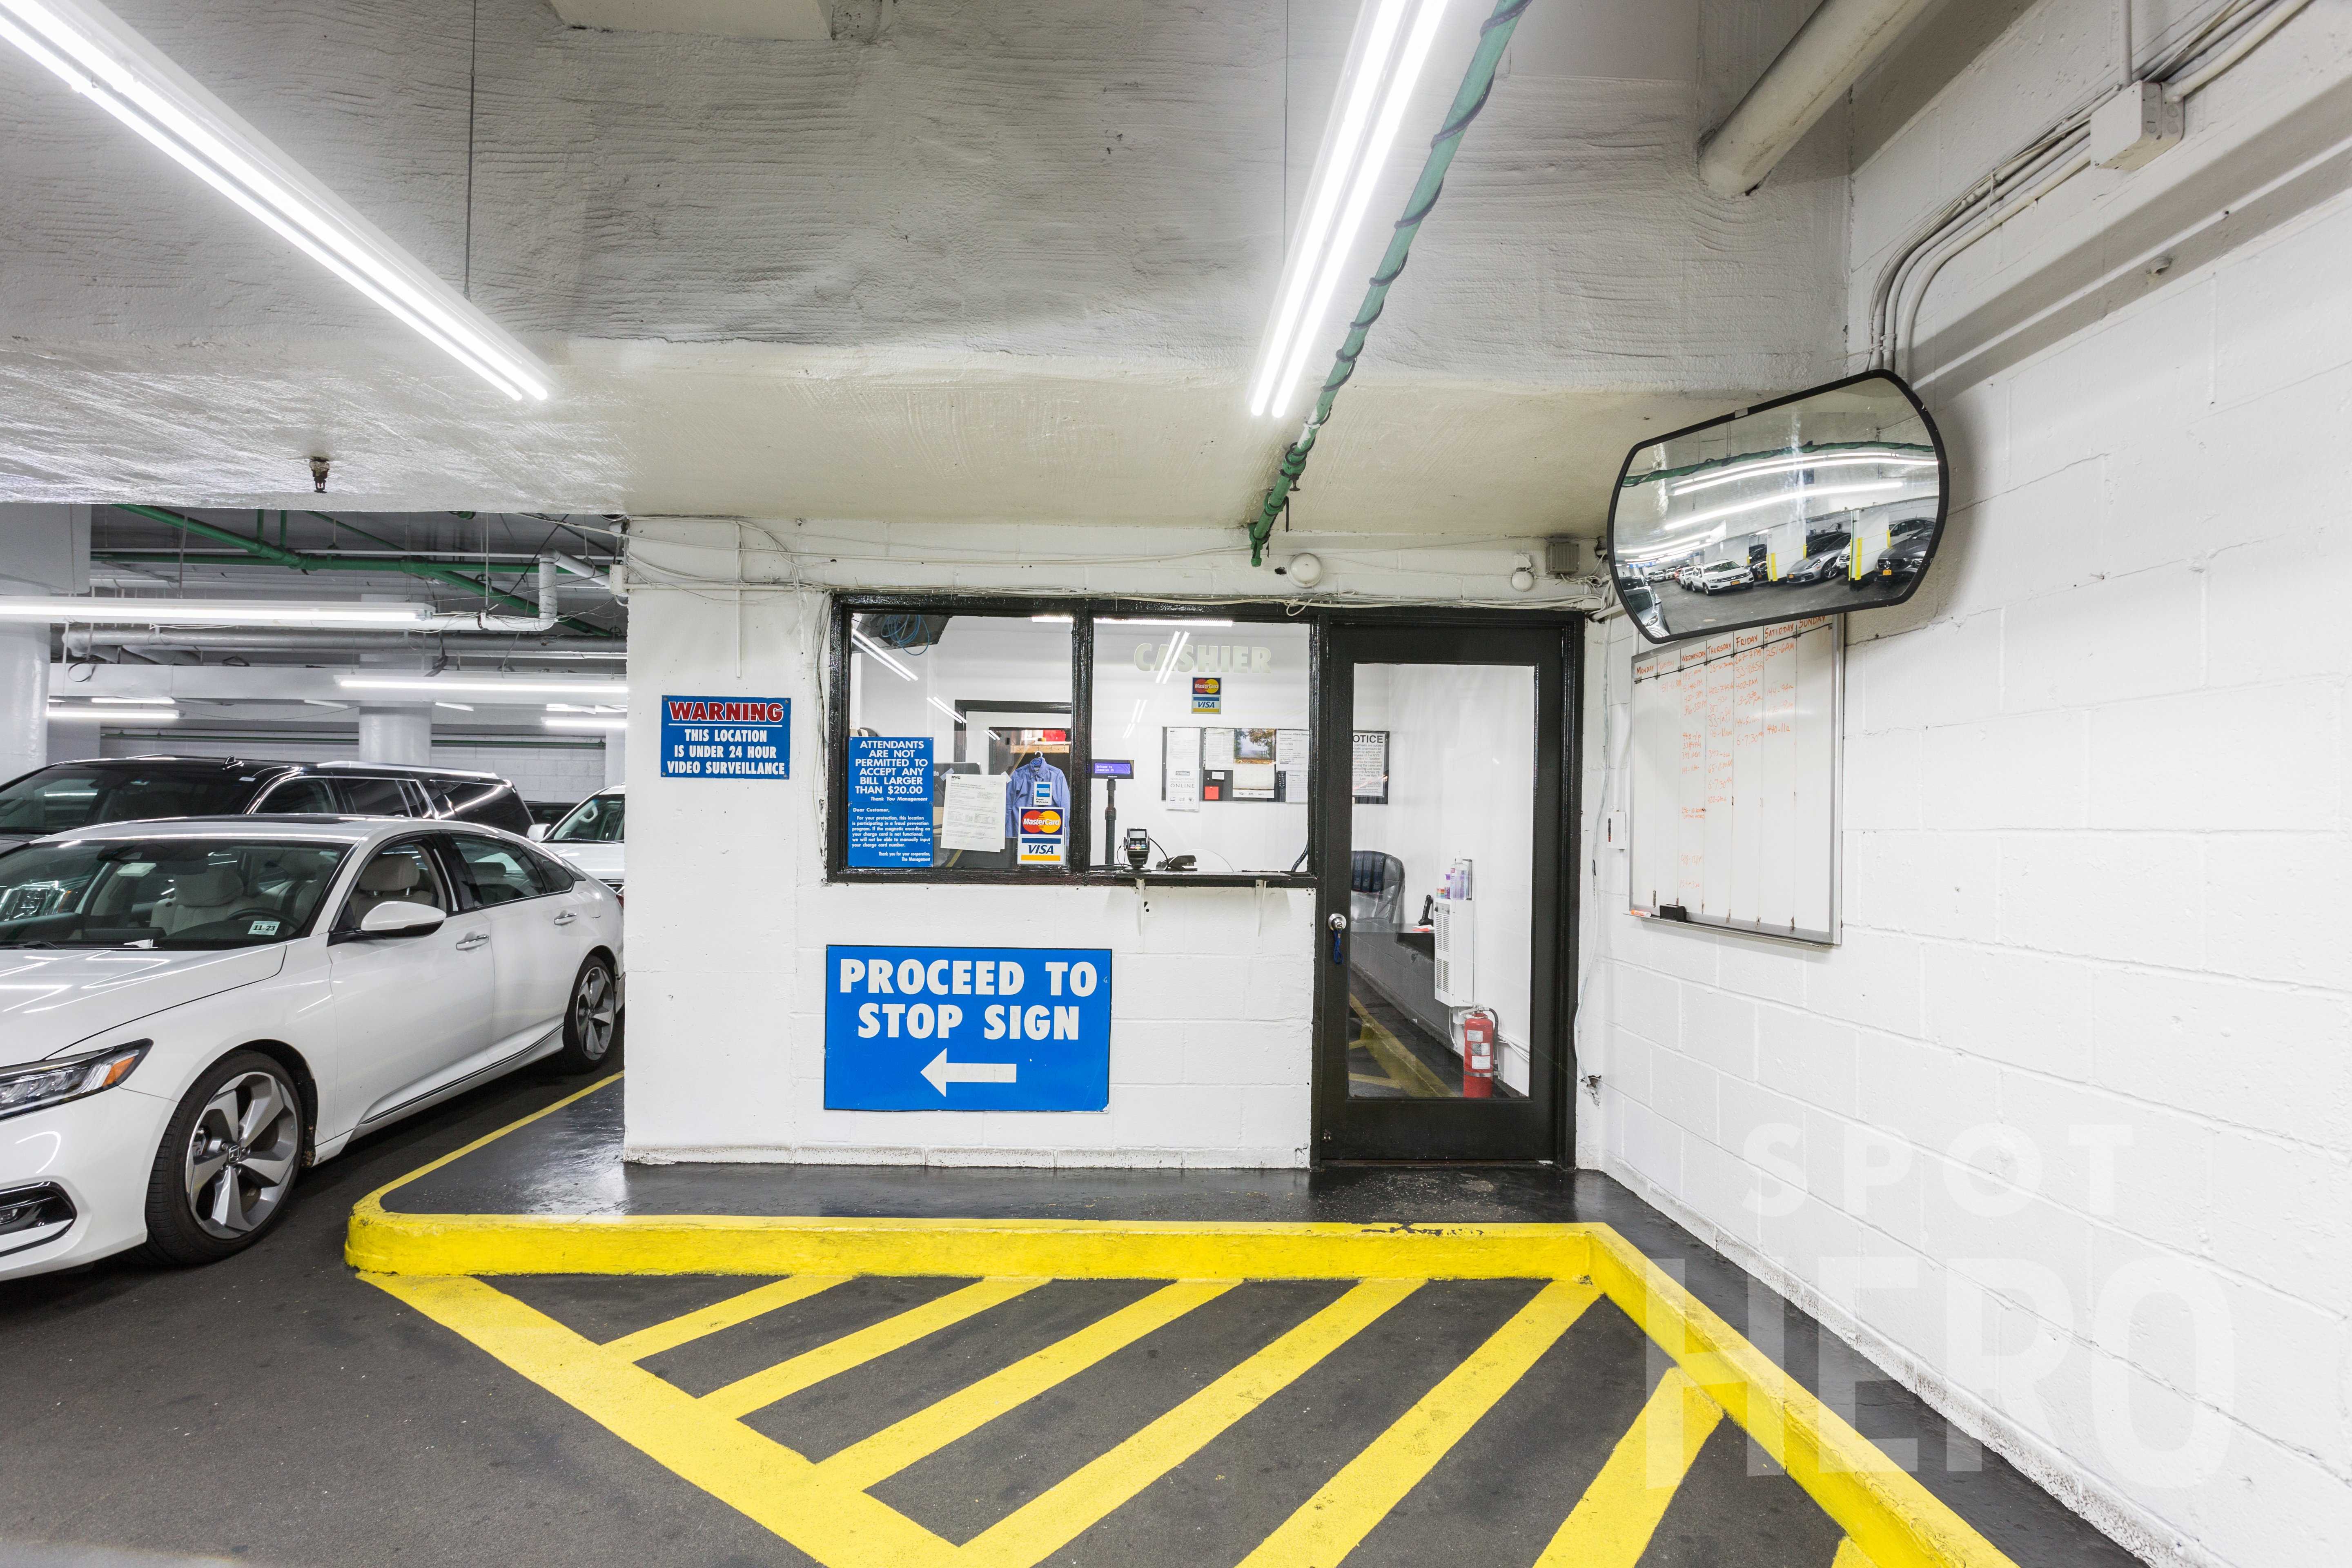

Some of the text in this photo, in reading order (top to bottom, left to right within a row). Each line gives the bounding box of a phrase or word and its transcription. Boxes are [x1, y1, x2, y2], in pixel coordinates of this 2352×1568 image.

[1799, 615, 1826, 629] SUNDAY
[1764, 623, 1794, 639] SATURDAY
[1736, 635, 1758, 648] FRIDAY
[1707, 643, 1731, 654] THURSDAY
[1134, 643, 1272, 674] CASHIER
[1682, 650, 1706, 662] WEDNESDAY
[1637, 665, 1654, 675] MONDAY
[668, 702, 784, 722] WARNING
[685, 729, 767, 742] THIS LOCATION
[1353, 735, 1383, 743] OTICE
[675, 745, 776, 758] IS UNDER 24 HOUR
[667, 761, 784, 775] VIDEO SURVEILLANCE
[888, 786, 922, 795] $20.00
[1029, 845, 1054, 854] VISA
[840, 959, 1097, 997] PROCEED TO
[858, 1003, 1079, 1040] STOP SIGN
